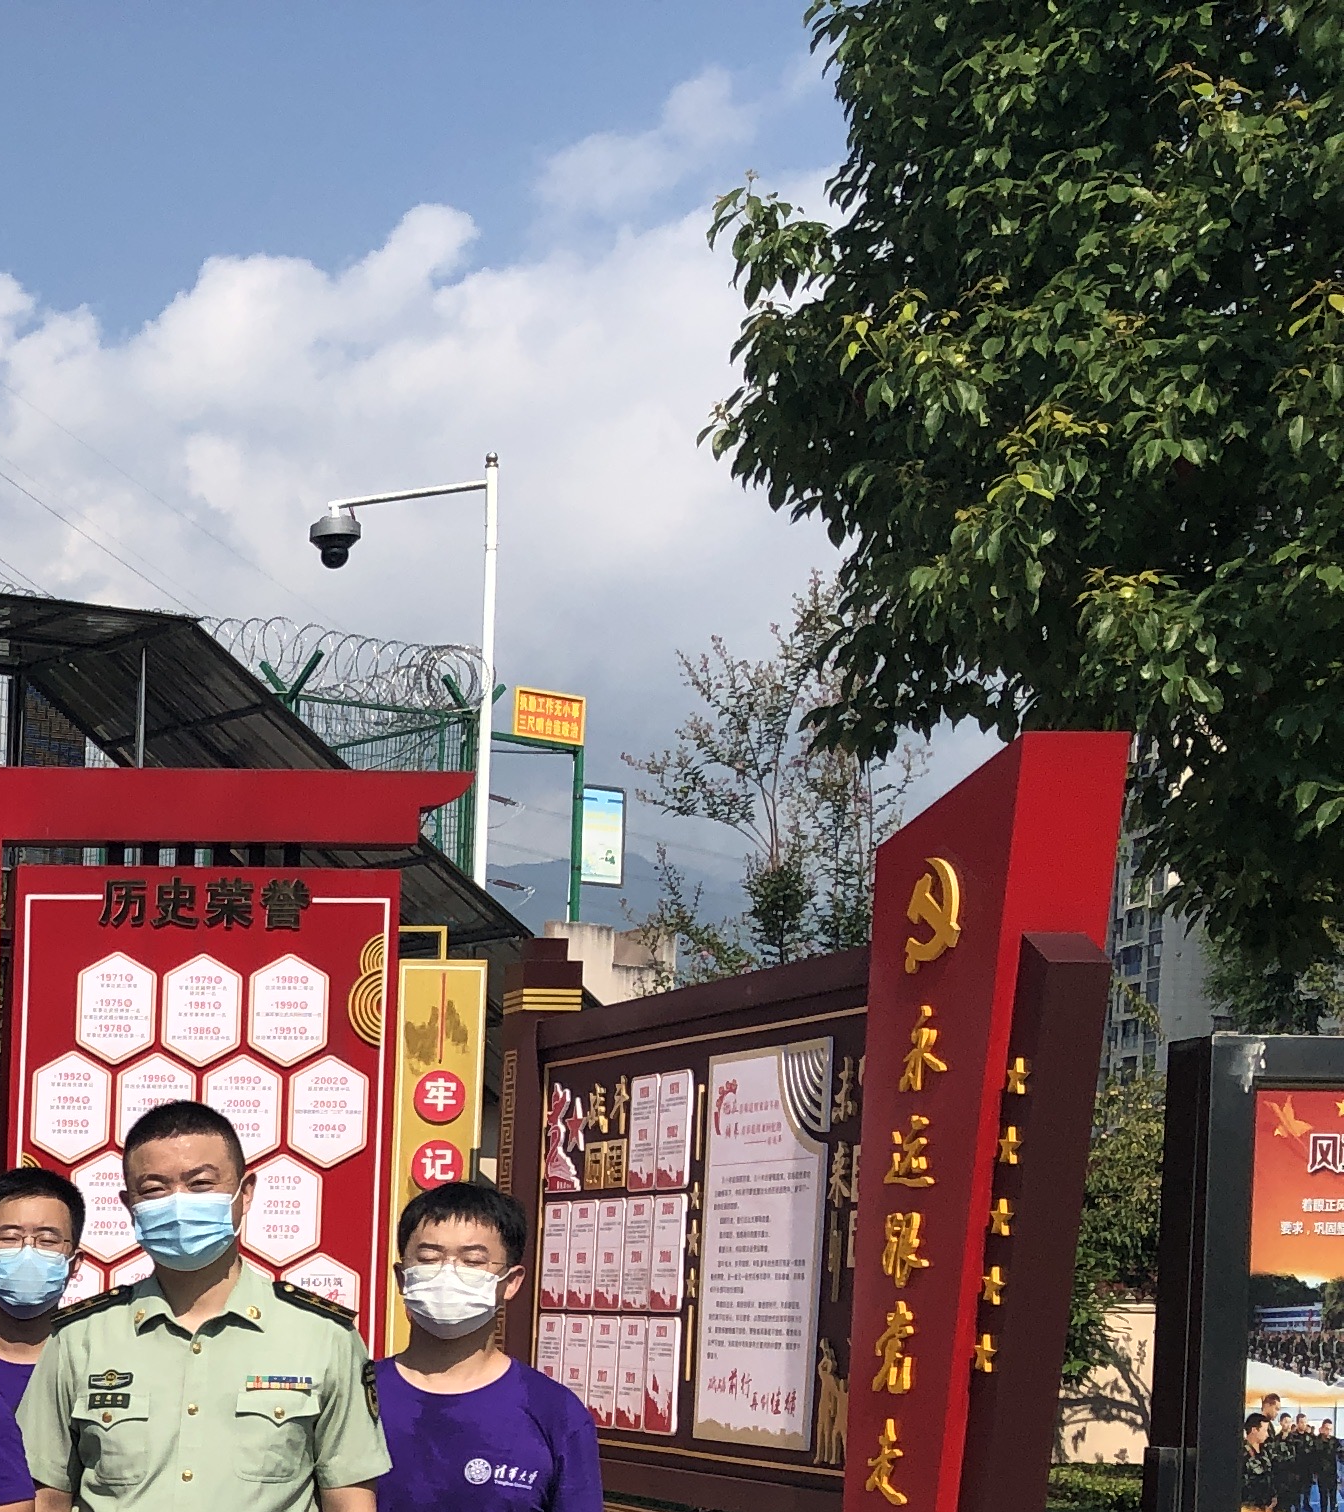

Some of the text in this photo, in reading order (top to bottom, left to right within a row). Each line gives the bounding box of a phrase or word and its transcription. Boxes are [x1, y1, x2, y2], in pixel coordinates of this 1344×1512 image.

[98, 876, 310, 929] 历史荣誉
[420, 1078, 457, 1181] 牢记
[1307, 1133, 1344, 1173] 风
